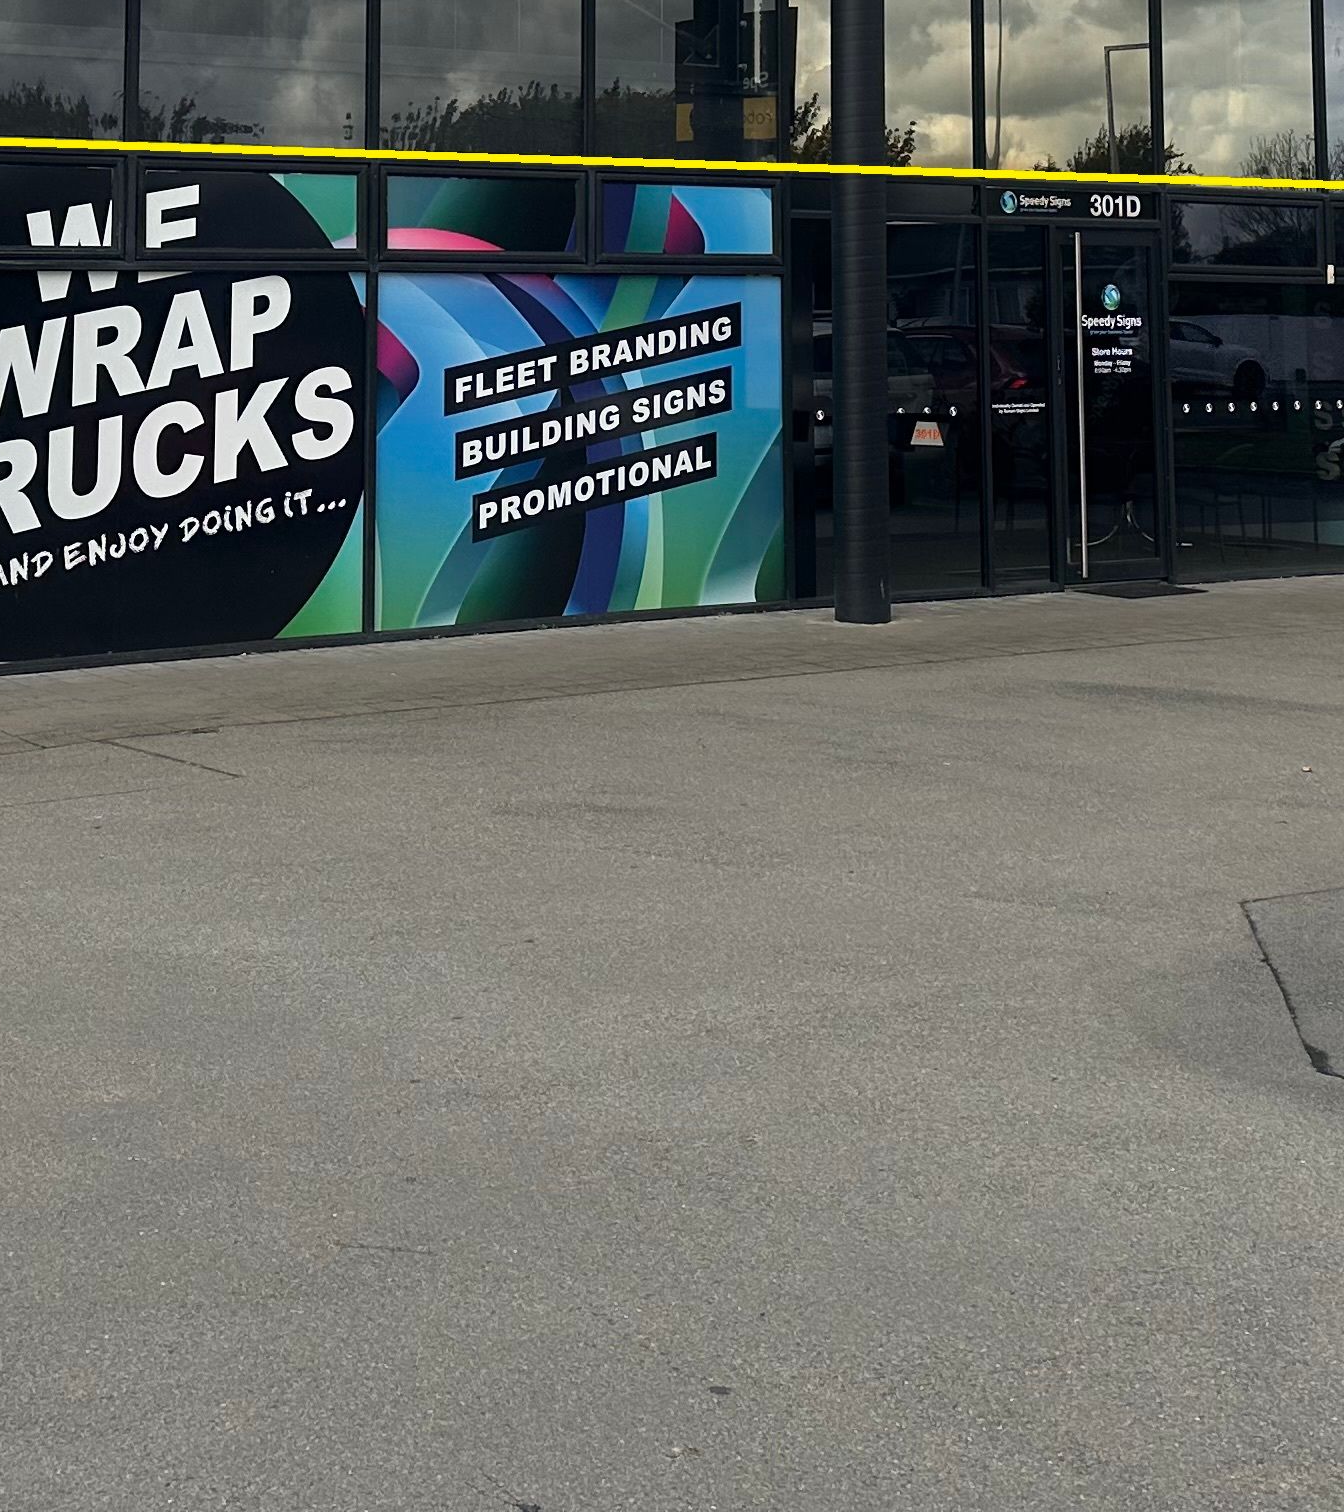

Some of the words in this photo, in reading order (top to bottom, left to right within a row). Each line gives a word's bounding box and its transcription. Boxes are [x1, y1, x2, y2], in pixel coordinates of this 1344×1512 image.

[26, 184, 200, 303] WE
[1019, 194, 1049, 208] Speedy
[1050, 195, 1072, 208] Signs
[1089, 194, 1141, 218] 301D
[455, 355, 558, 403] FLEET
[569, 316, 732, 376] BRANDING
[1081, 314, 1116, 329] Speedy
[1116, 314, 1142, 329] Signs
[462, 407, 621, 468] BUILDING
[632, 379, 726, 423] SIGNS
[478, 445, 712, 530] PROMOTIONAL
[63, 523, 170, 571] ENJOY
